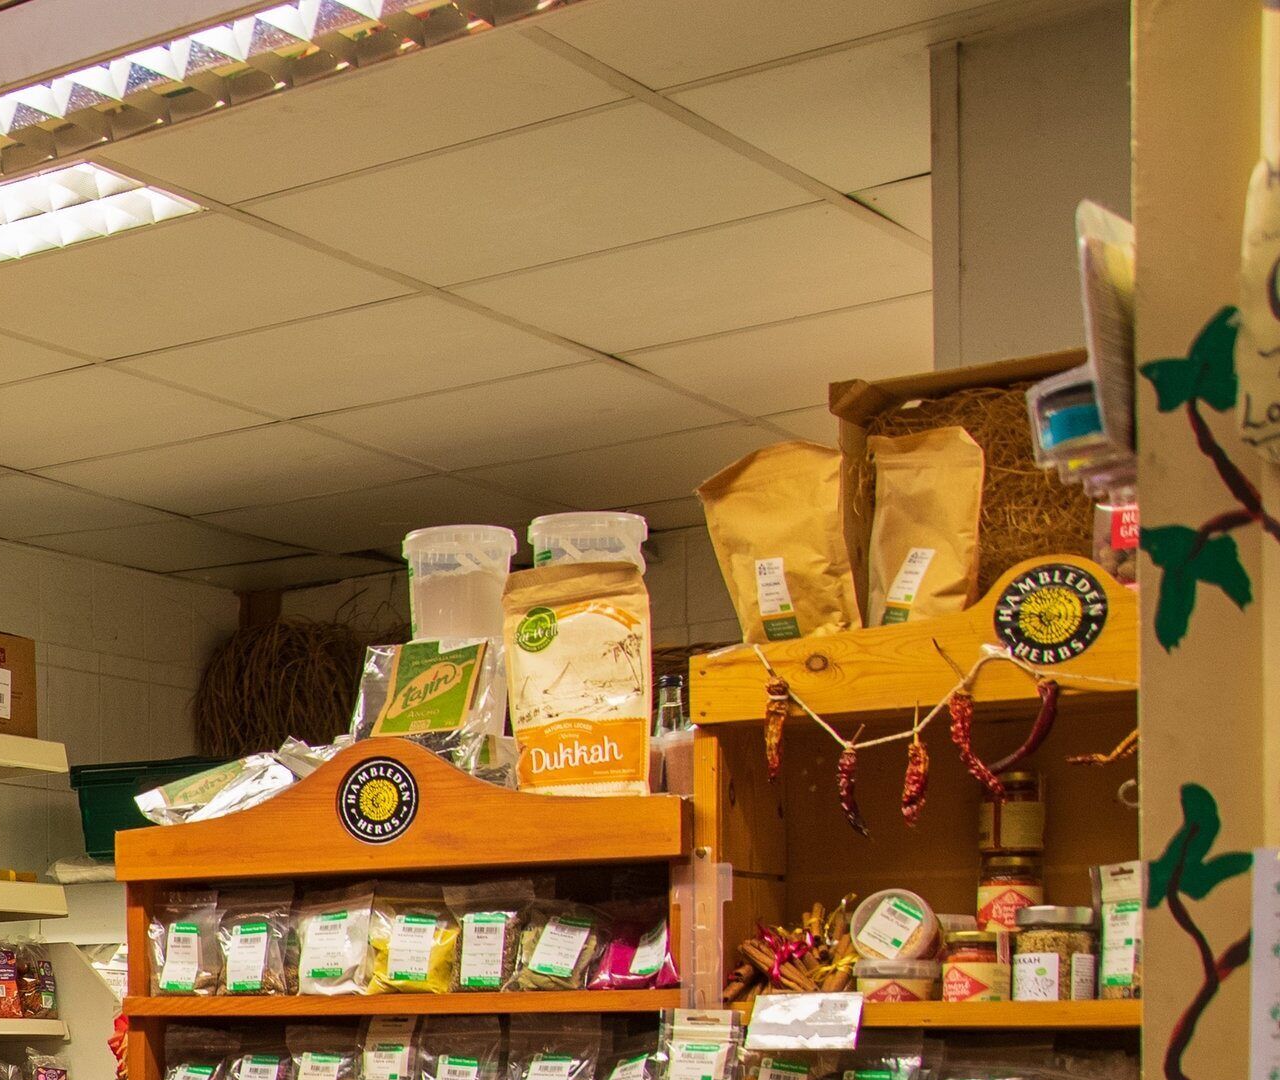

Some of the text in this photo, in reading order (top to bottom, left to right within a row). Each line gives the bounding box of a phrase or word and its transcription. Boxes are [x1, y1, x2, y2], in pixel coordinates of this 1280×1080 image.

[999, 568, 1106, 624] HAMBLEDEN
[1014, 638, 1086, 665] HERBS
[530, 734, 624, 775] Dukkah
[347, 767, 412, 809] HAMBLEDEN
[357, 815, 401, 836] HERBS
